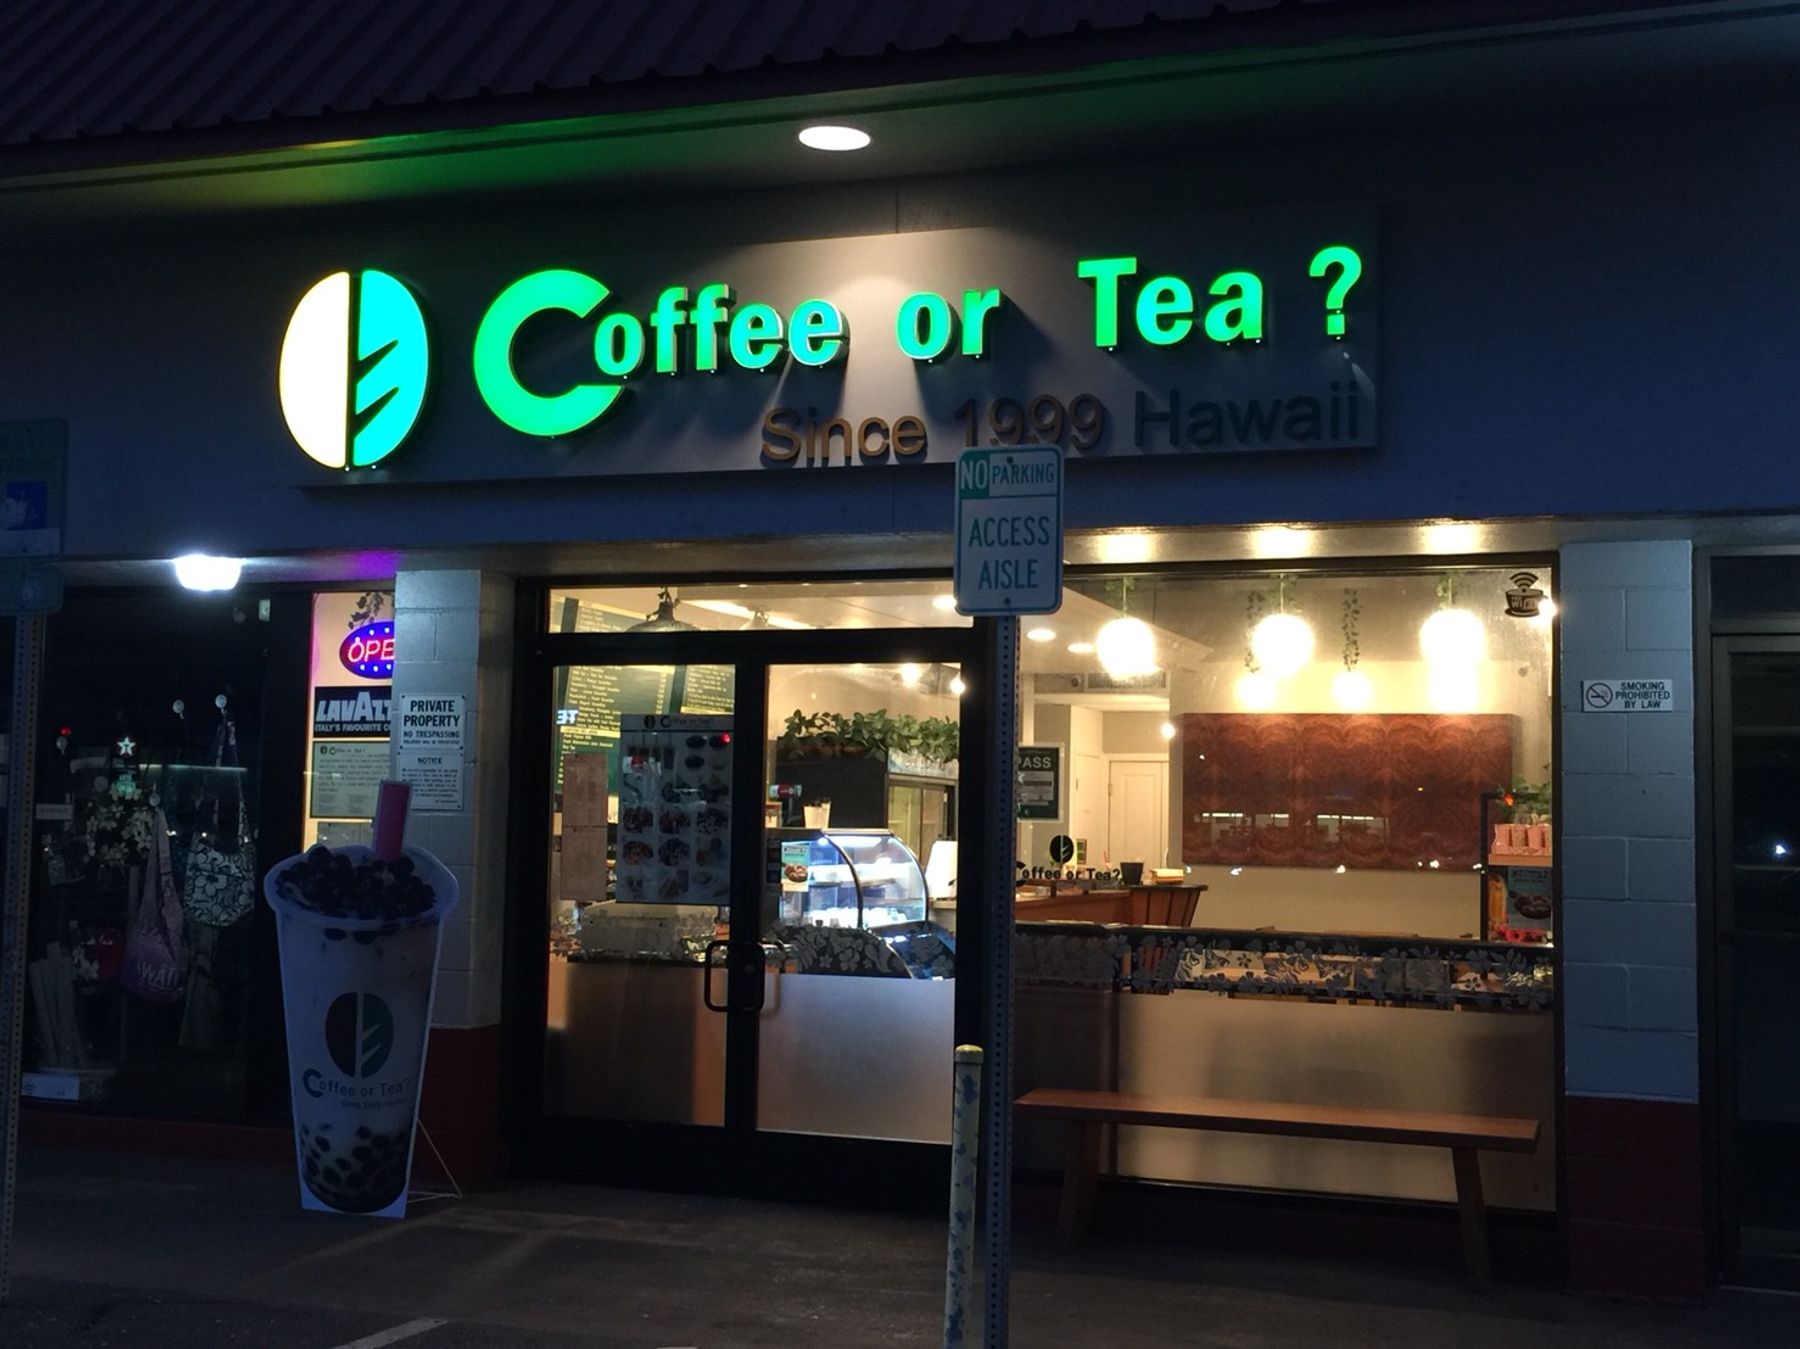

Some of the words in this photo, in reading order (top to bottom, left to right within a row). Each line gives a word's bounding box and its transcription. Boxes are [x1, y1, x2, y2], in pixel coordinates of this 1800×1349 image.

[473, 269, 848, 437] Coffee
[896, 287, 1000, 361] or
[1077, 256, 1264, 347] Tea
[1308, 246, 1362, 336] ?
[762, 405, 928, 460] Since
[952, 393, 1103, 448] 1999
[1134, 381, 1361, 447] Hawaii
[960, 459, 988, 491] NO
[992, 462, 1055, 485] PARKING
[968, 515, 1051, 548] ACCESS
[977, 558, 1039, 590] AISLE
[348, 637, 395, 663] OPE
[1620, 681, 1665, 691] SMOKING
[1615, 690, 1671, 700] PROHIBITED
[410, 700, 455, 713] PRIVATE
[1624, 700, 1636, 709] BY
[1641, 700, 1661, 709] LAW
[403, 714, 461, 727] PROPERTY
[403, 730, 413, 738] NO
[416, 730, 460, 738] TRESPASSING
[417, 757, 443, 765] NOTICE
[1066, 869, 1083, 880] or
[1086, 868, 1122, 881] Tea?
[303, 1068, 357, 1098] Coffee
